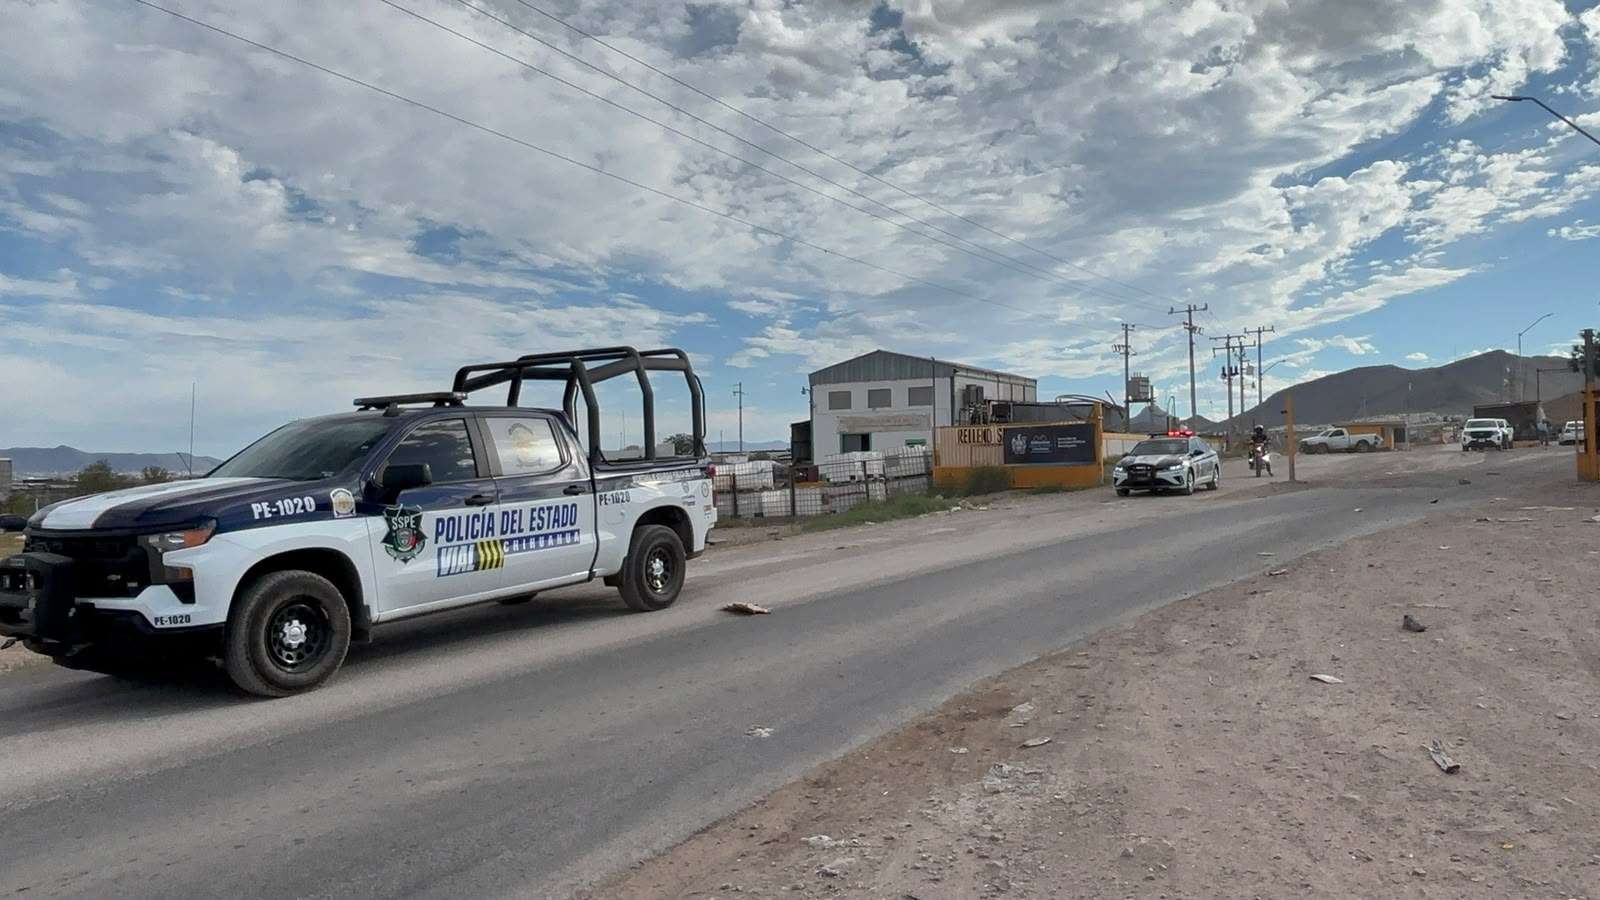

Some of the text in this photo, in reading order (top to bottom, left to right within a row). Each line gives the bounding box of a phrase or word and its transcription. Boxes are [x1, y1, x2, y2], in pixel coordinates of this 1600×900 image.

[251, 496, 316, 520] PE-1020
[598, 490, 631, 506] PE-1020
[391, 515, 416, 530] SSPE
[434, 503, 578, 544] POLICÍA DEL ESTADO
[503, 531, 580, 553] CHIHUAHUA
[439, 543, 476, 576] VIAL
[154, 614, 191, 626] PE-1020
